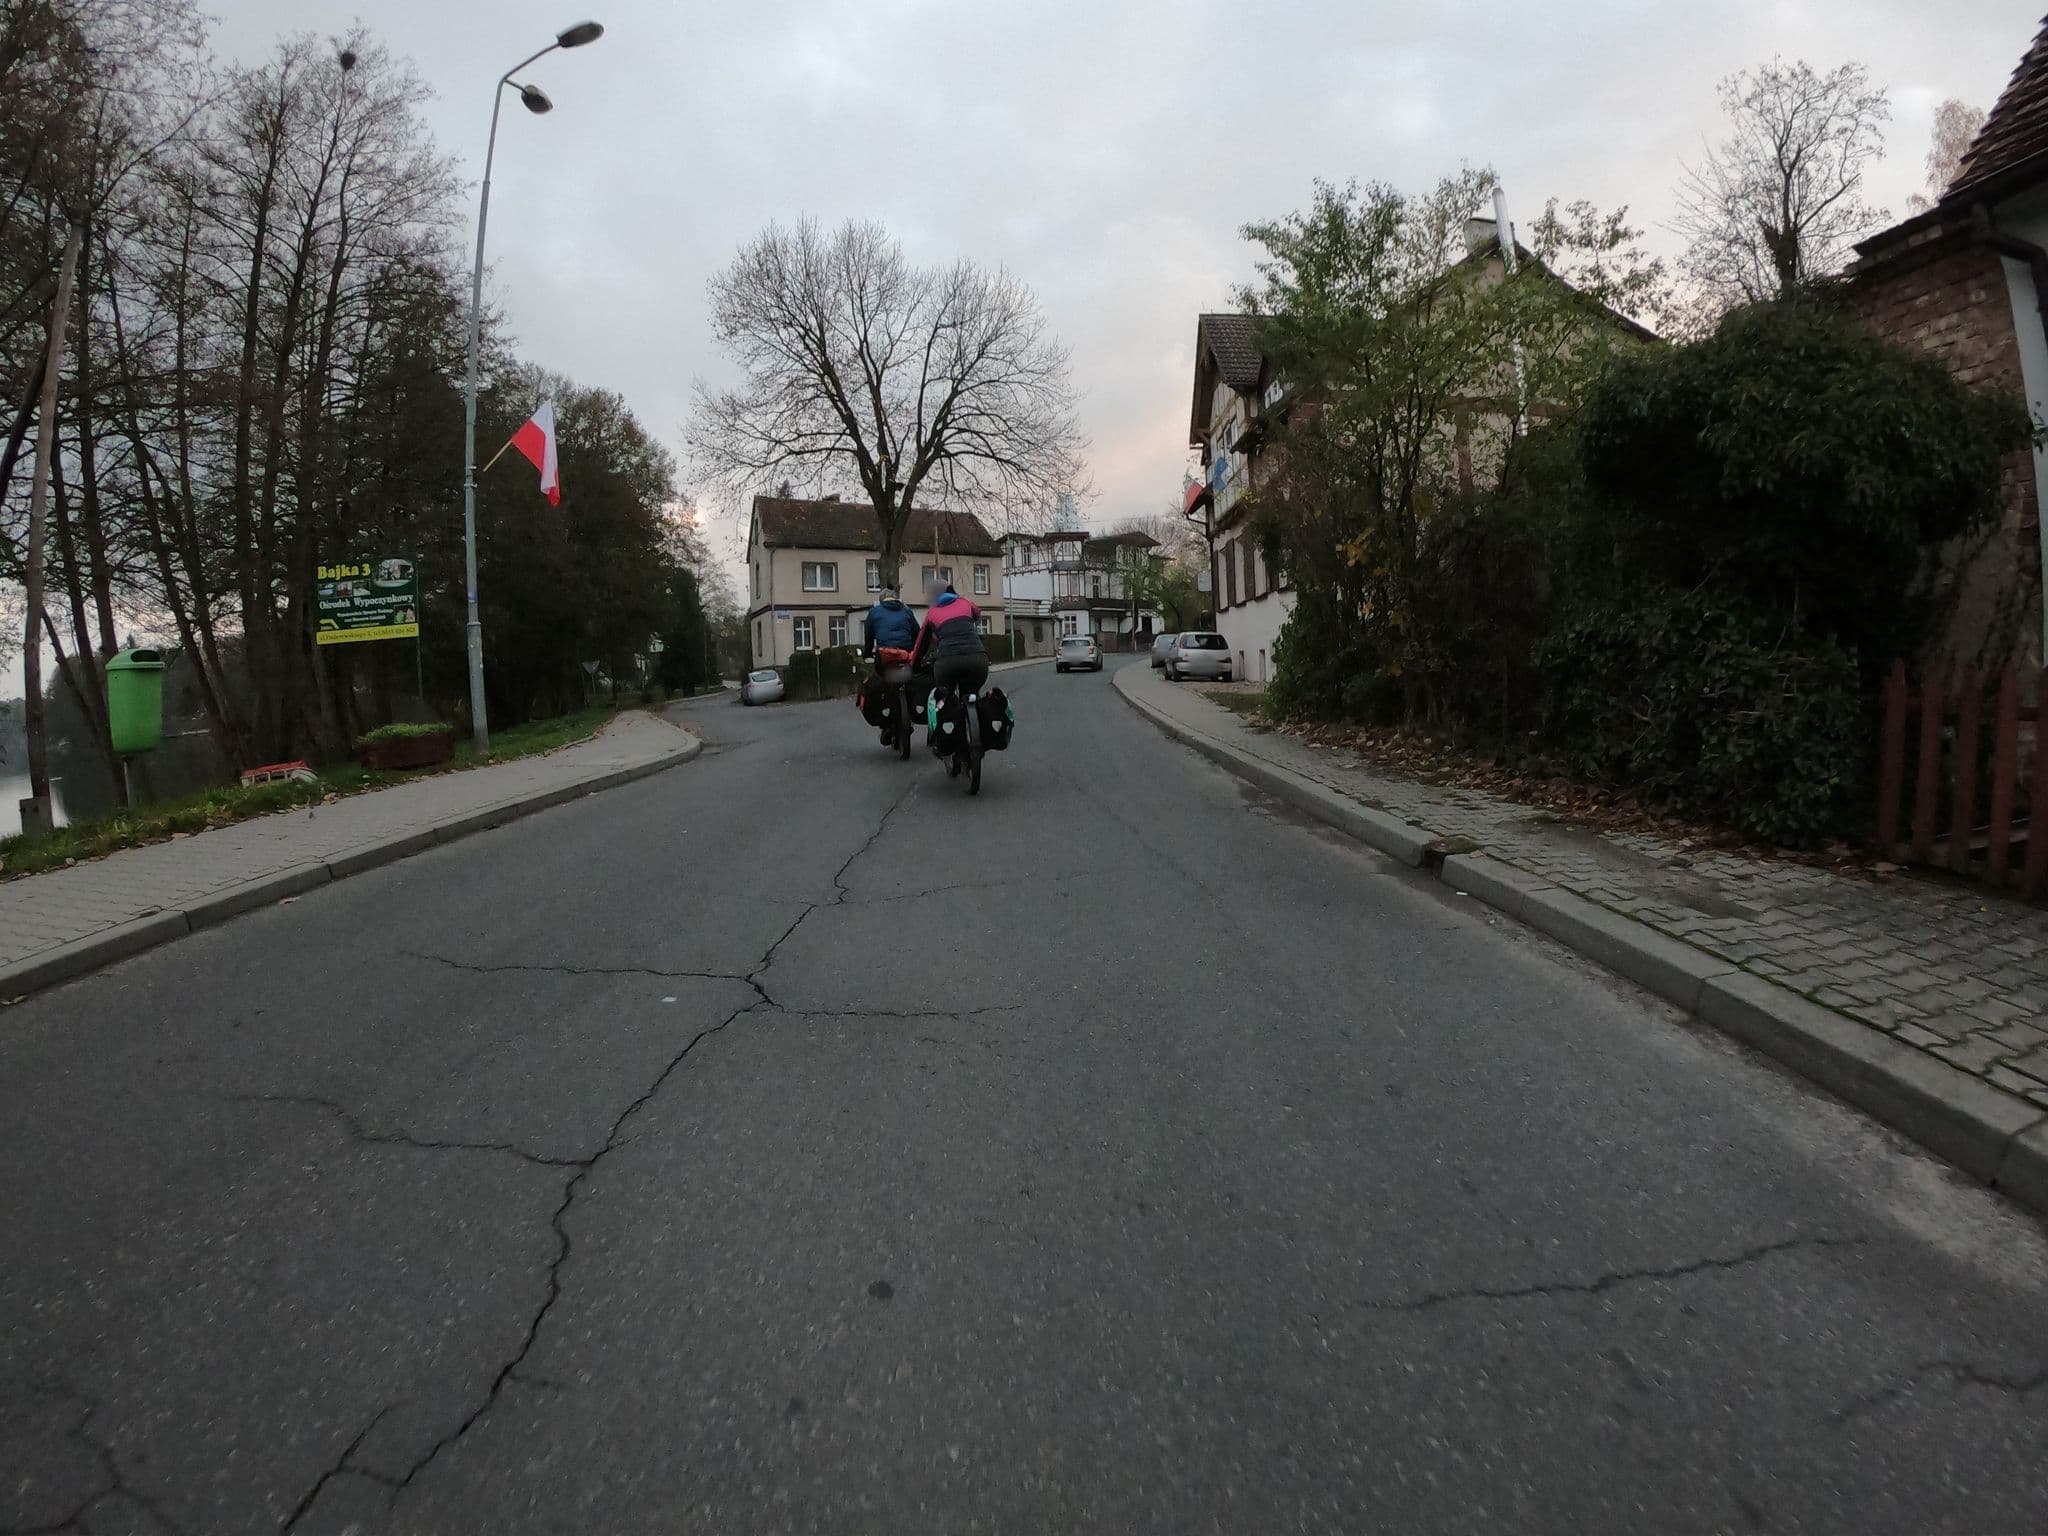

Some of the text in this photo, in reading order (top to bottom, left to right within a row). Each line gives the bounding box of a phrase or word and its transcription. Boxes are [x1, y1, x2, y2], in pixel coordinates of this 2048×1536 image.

[317, 563, 371, 580] Bajka 3
[319, 594, 414, 610] Ośrodek Wypoczynkowy
